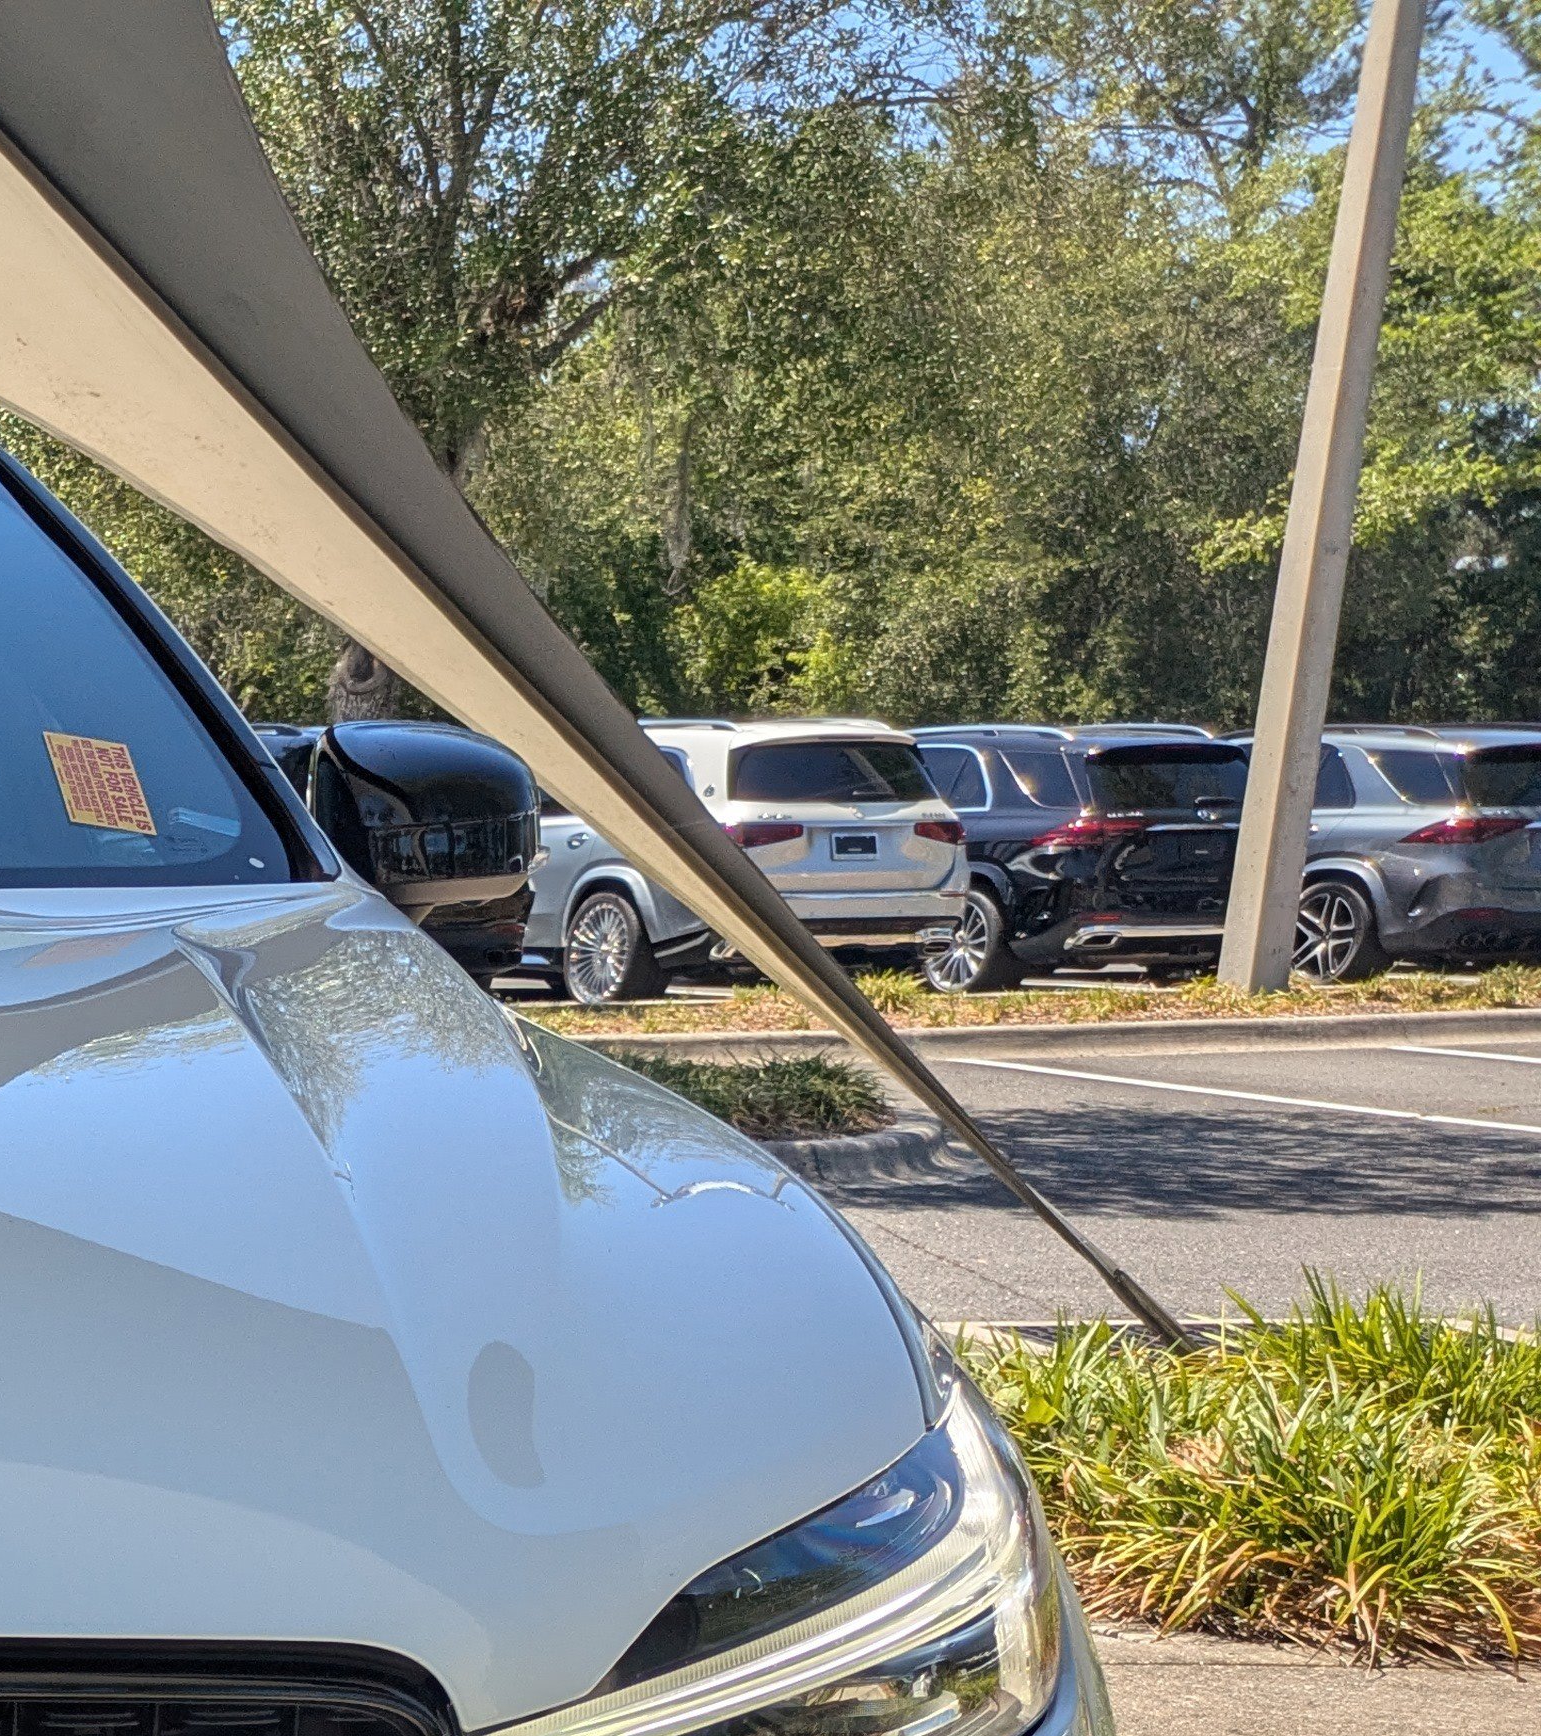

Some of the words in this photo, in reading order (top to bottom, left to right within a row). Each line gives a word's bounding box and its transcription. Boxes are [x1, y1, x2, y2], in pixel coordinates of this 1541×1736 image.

[94, 747, 115, 770] NOT
[110, 746, 131, 770] THIS
[103, 771, 123, 793] FOR
[119, 772, 147, 817] VEHICLE
[111, 795, 134, 824] SALE
[135, 820, 152, 831] IS
